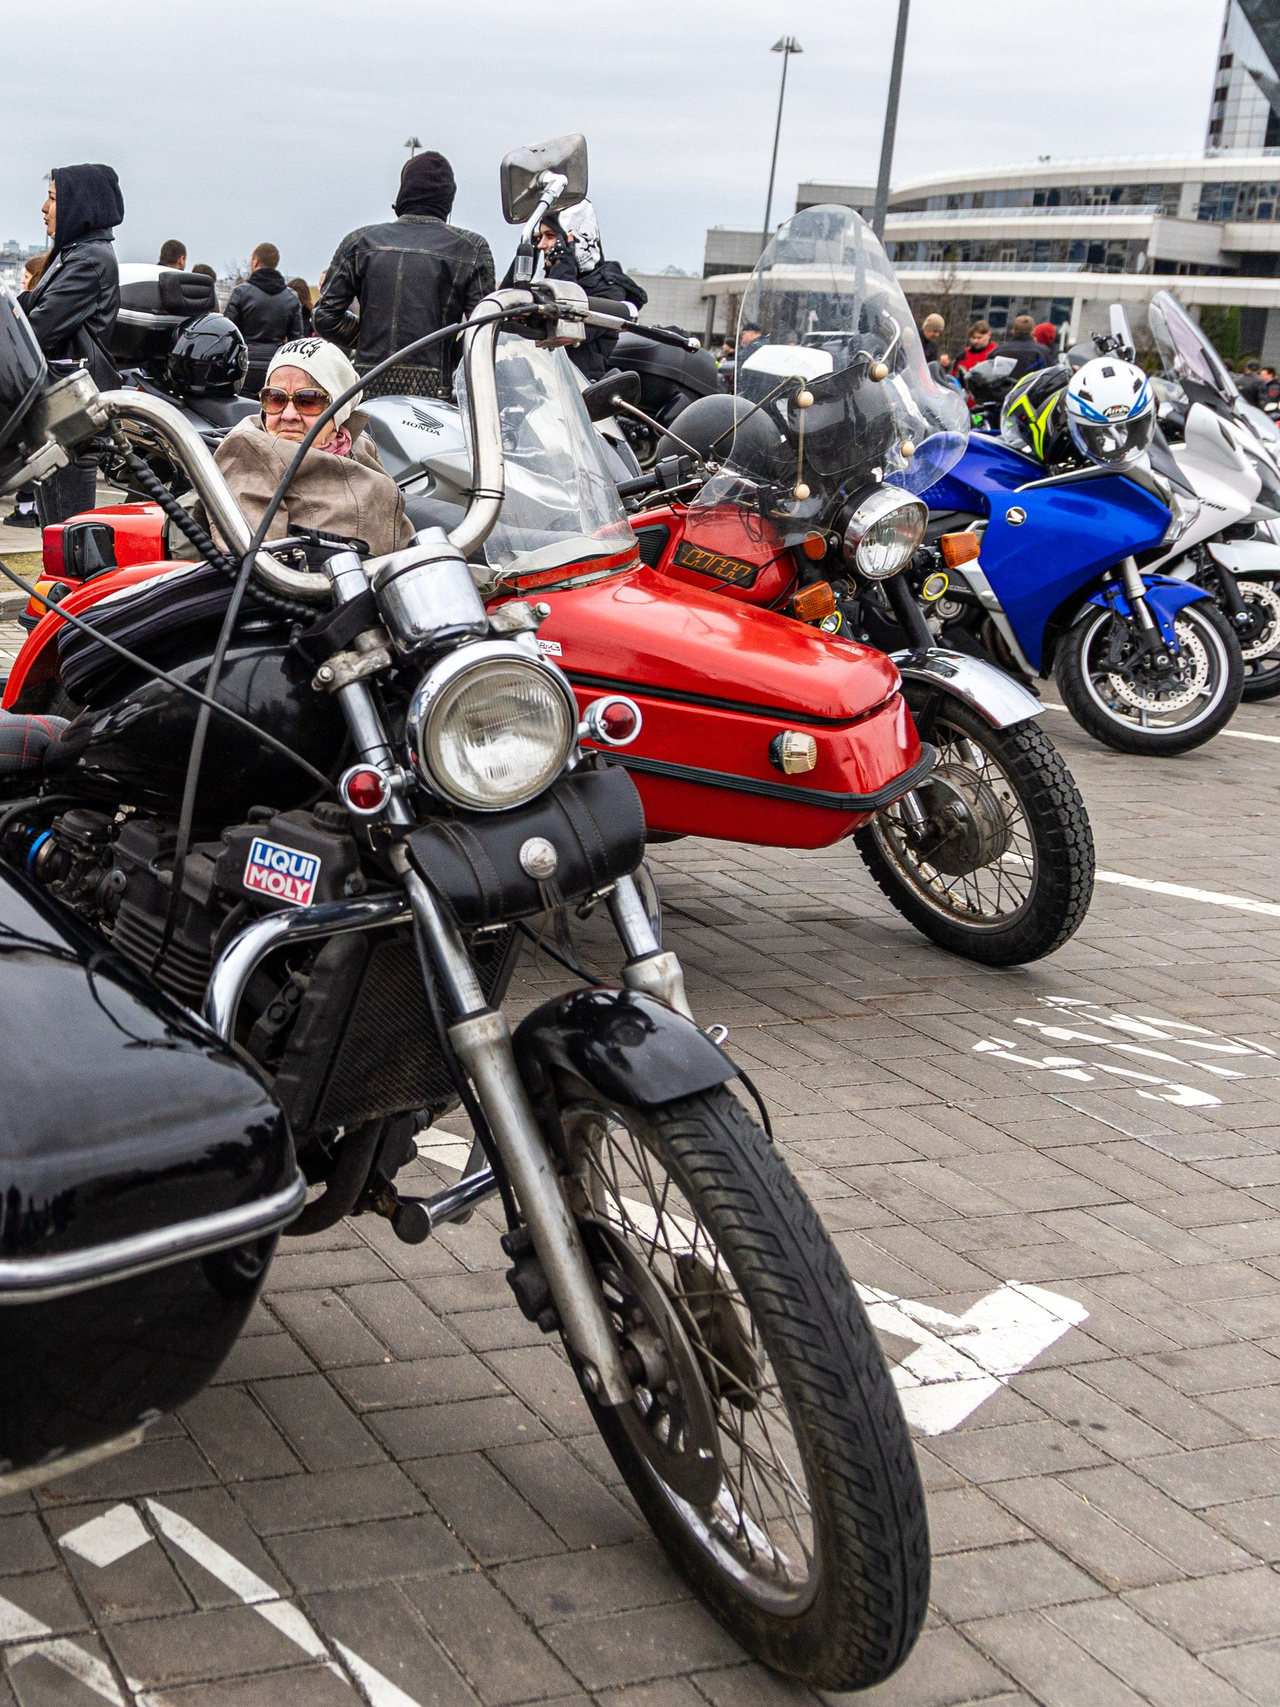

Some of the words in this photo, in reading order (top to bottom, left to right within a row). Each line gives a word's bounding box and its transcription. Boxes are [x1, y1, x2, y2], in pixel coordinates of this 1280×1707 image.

[402, 420, 440, 436] HONDA
[253, 844, 314, 880] LIQUI
[248, 865, 311, 901] MOLY
